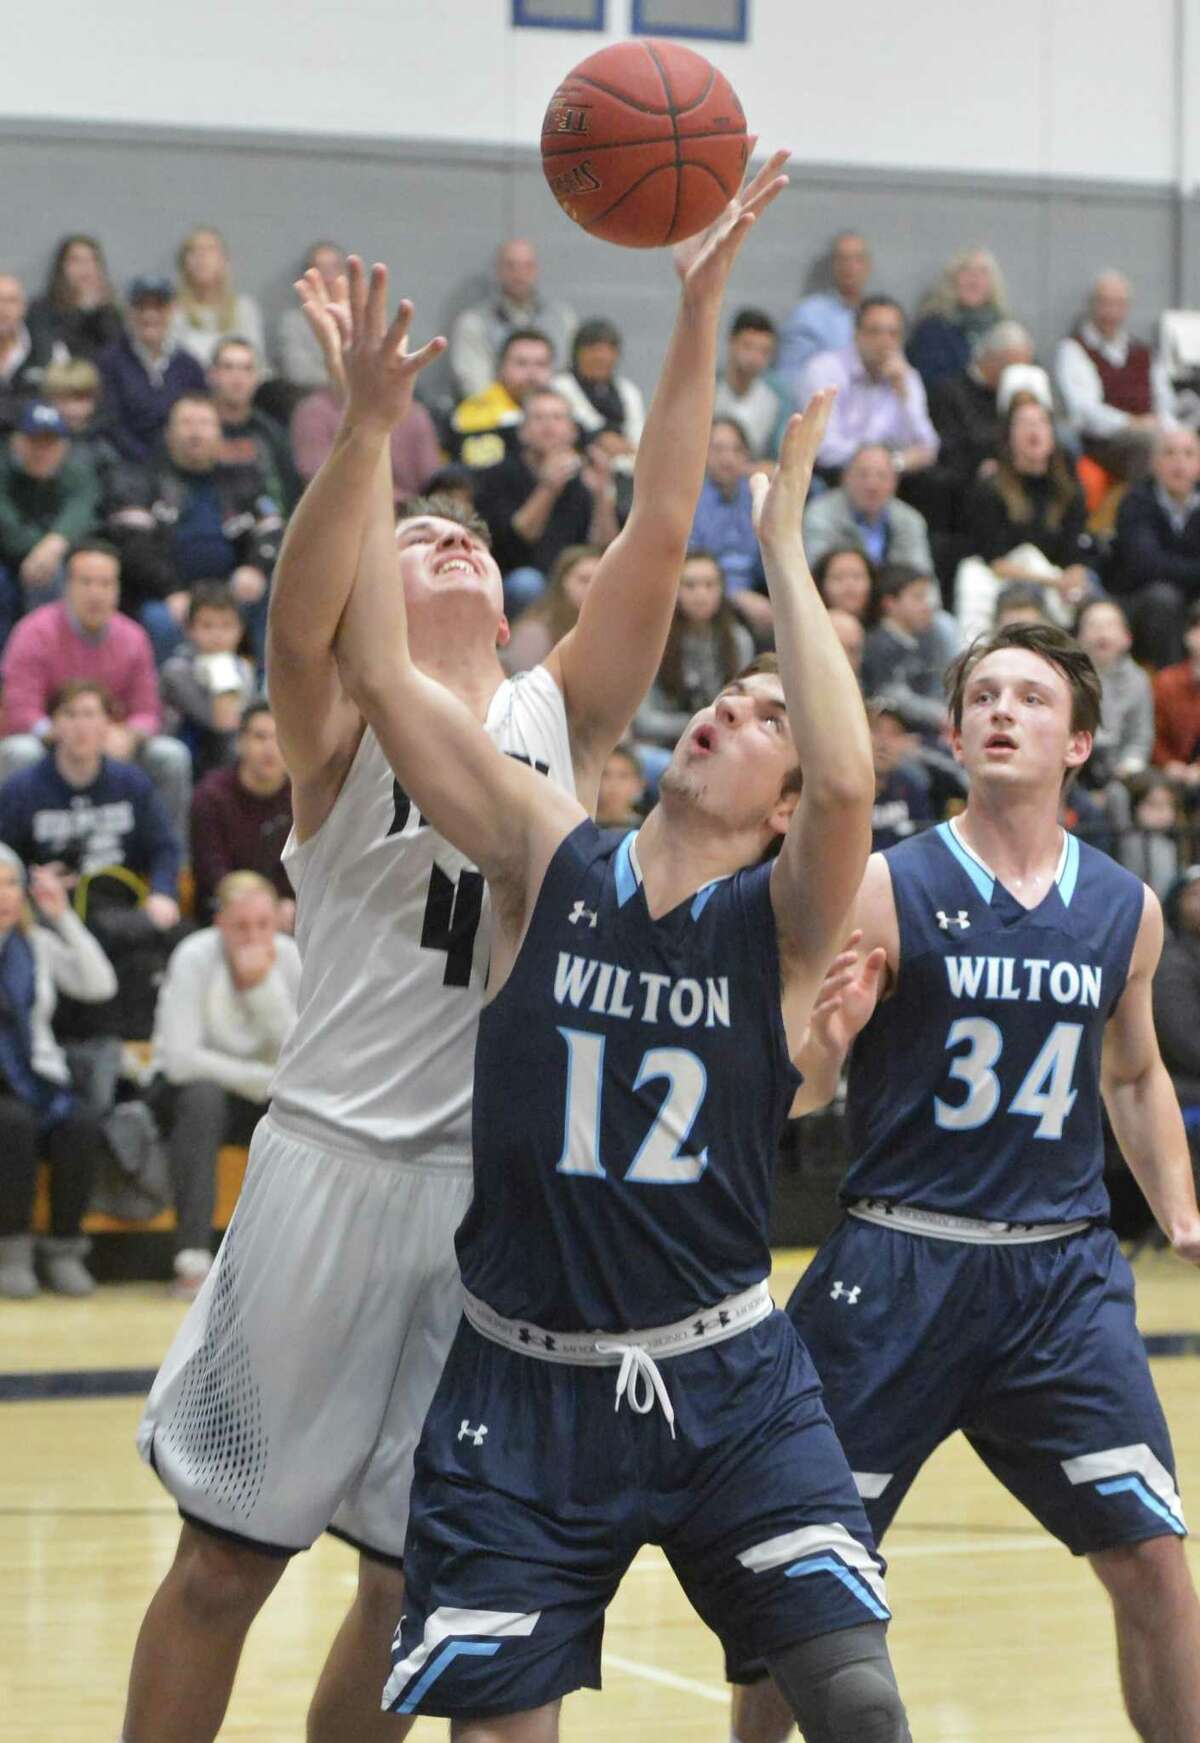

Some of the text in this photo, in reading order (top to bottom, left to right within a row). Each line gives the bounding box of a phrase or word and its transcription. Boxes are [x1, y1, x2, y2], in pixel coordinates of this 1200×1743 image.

[553, 952, 731, 1028] WILTON
[944, 956, 1103, 1010] WILTON
[556, 1026, 708, 1184] 12
[934, 1016, 1084, 1140] 34
